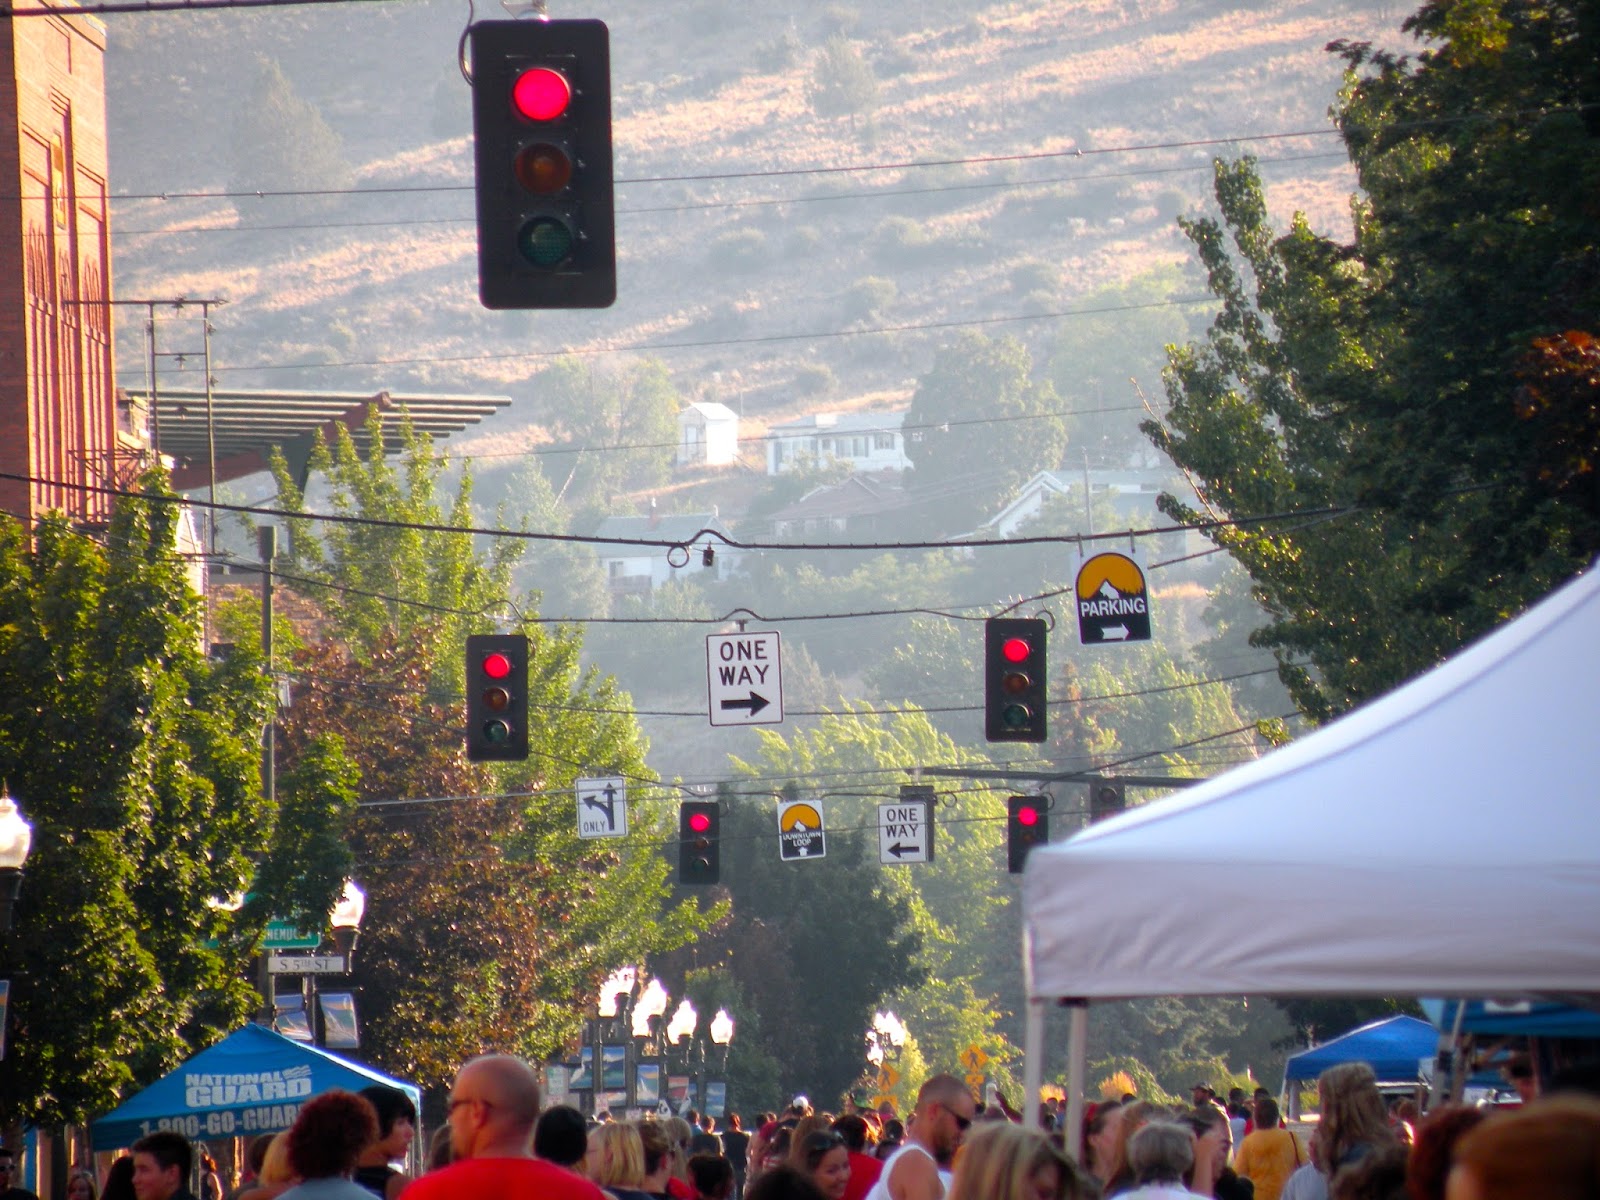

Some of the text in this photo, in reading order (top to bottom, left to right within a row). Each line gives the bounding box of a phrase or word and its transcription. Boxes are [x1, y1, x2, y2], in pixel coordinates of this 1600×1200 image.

[1080, 597, 1146, 617] PARKING
[720, 639, 768, 661] ONE
[719, 665, 770, 686] WAY
[887, 807, 918, 822] ONE
[583, 821, 605, 833] ONLY
[886, 824, 919, 838] WAY
[793, 838, 812, 847] LOOP
[280, 959, 329, 971] S 5TH ST
[186, 1071, 283, 1087] NATIONAL
[186, 1078, 312, 1108] GUARD
